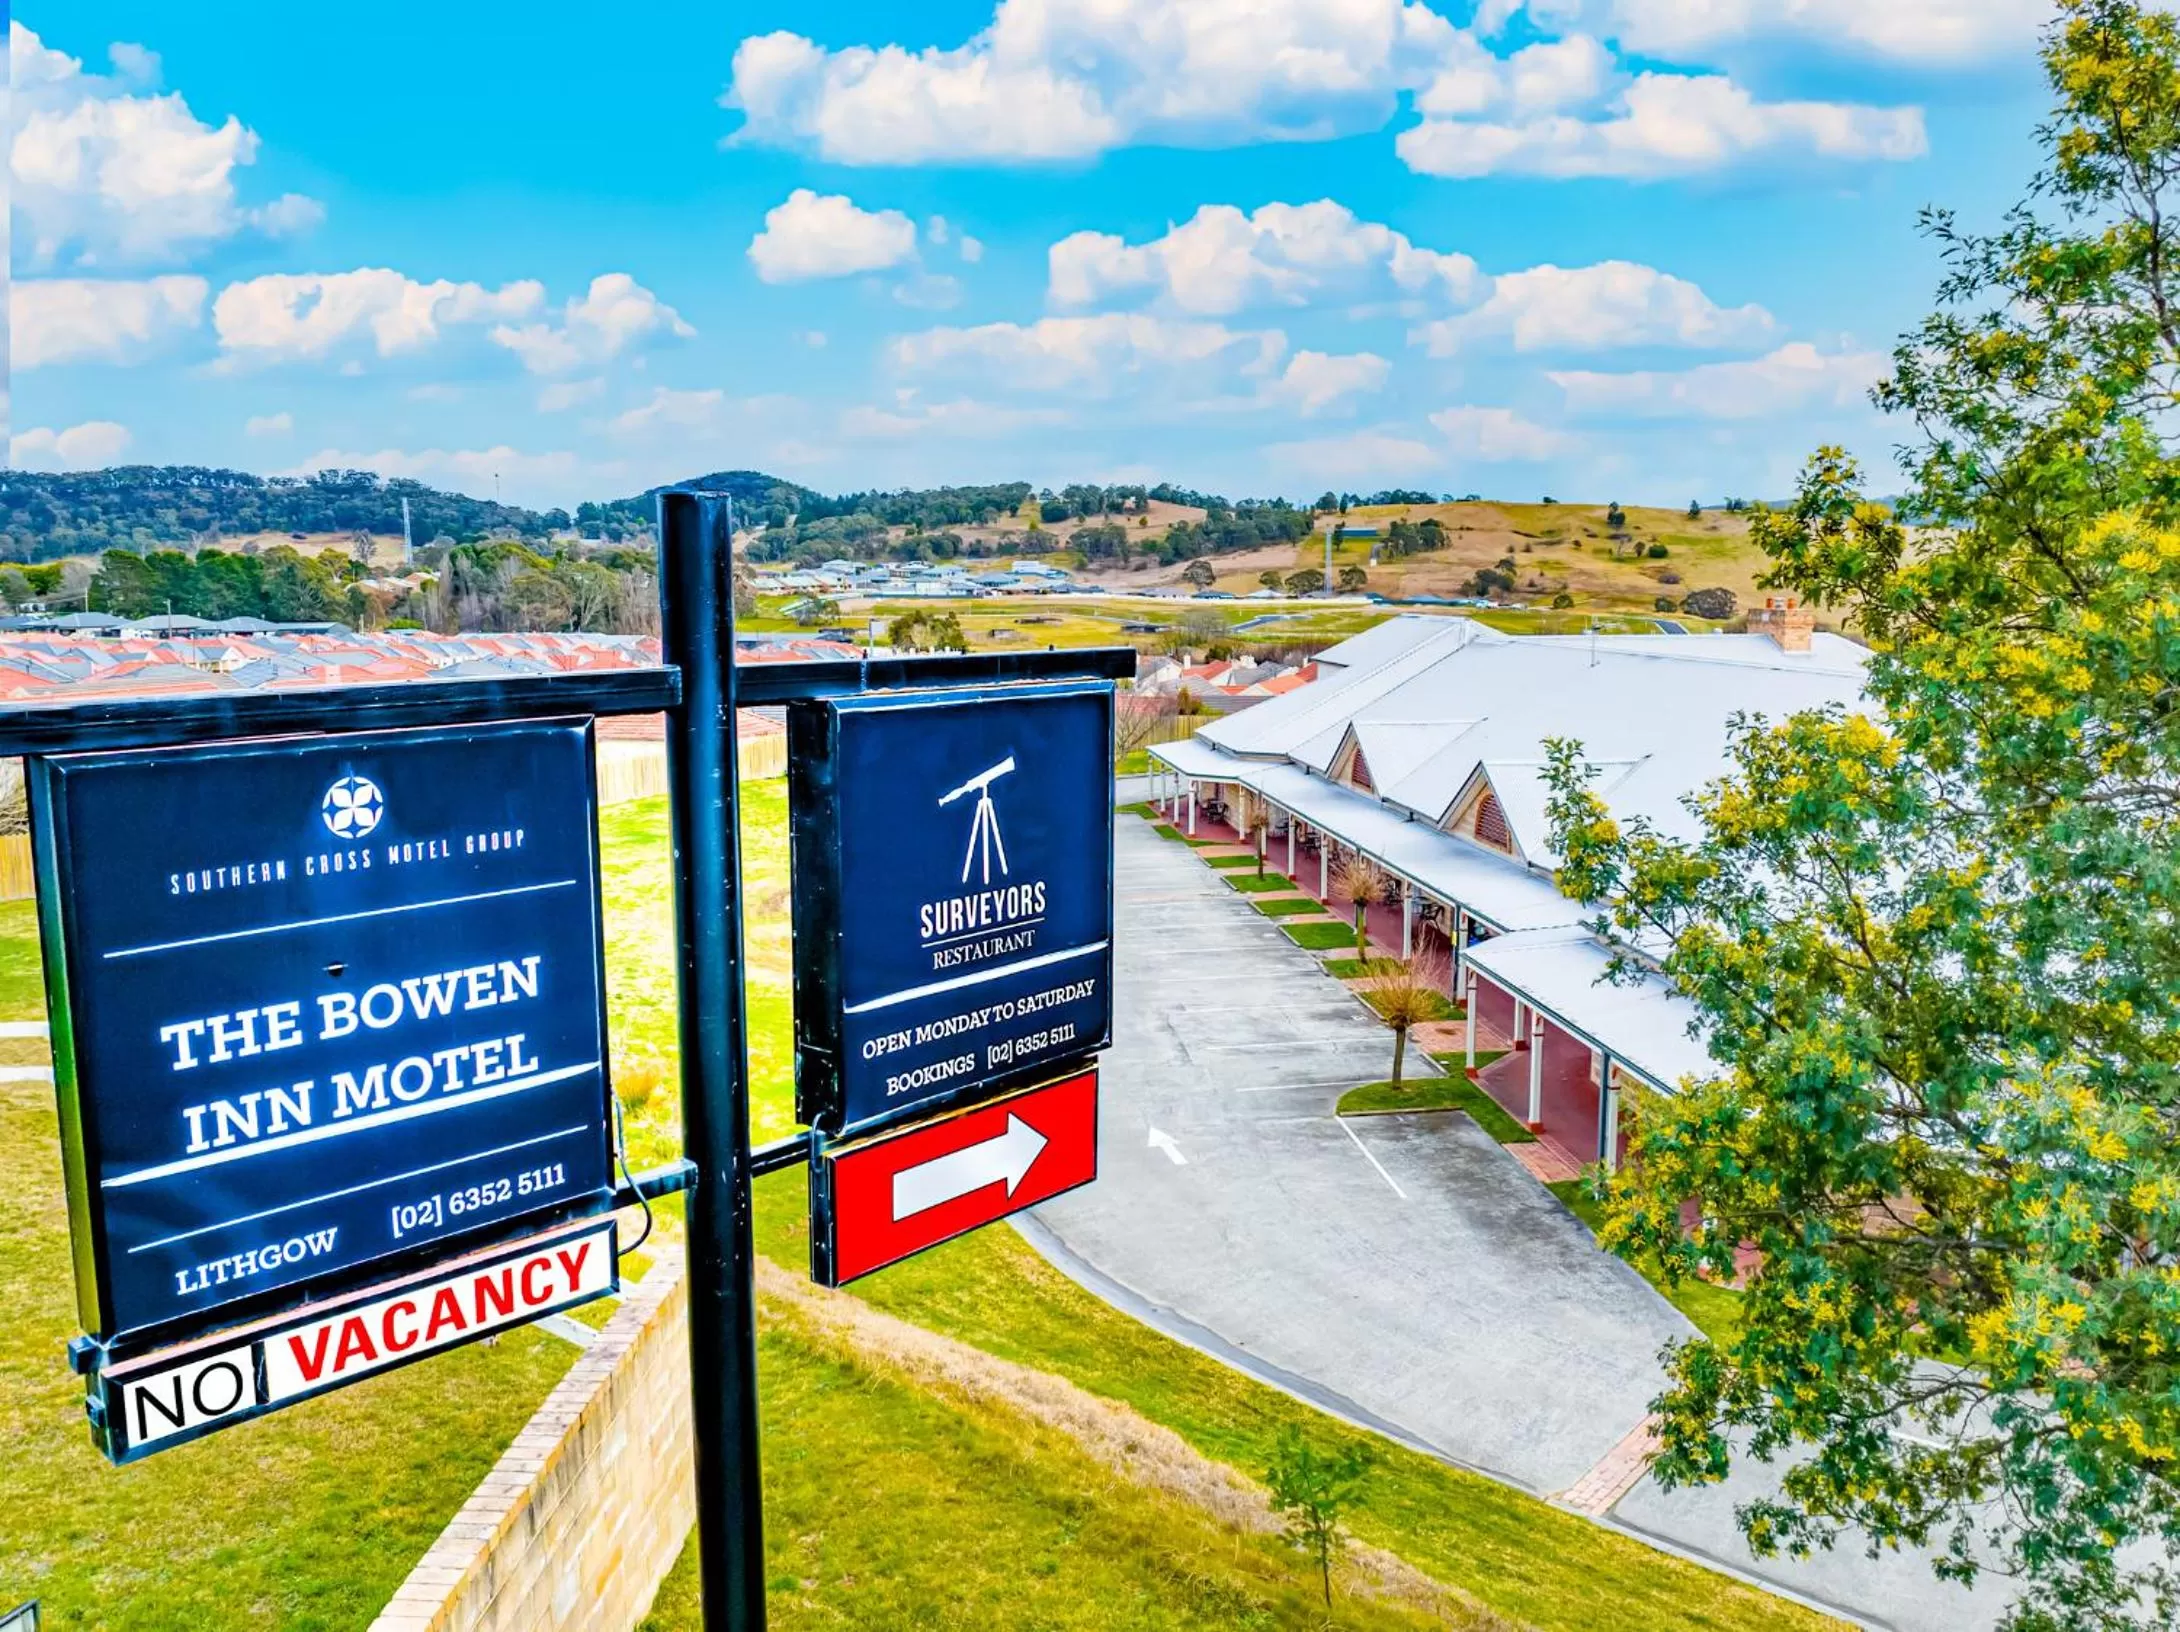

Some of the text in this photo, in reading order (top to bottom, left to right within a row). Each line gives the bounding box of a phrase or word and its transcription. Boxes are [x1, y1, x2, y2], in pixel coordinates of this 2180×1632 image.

[170, 829, 525, 896] SOUTHERN CROSS MOTEL GROUP
[920, 881, 1046, 939] SURVEYORS
[932, 930, 1036, 970] RESTAURANT
[160, 955, 542, 1072] THE BOWEN
[862, 979, 1096, 1060] OPEN MONDAY TO SATURDAY
[182, 1034, 539, 1154] INN MOTEL
[886, 1023, 1076, 1097] BOOKINGS [02] 6352 5111
[175, 1163, 566, 1296] LITHGOW [02] 6352 5111
[134, 1242, 591, 1441] NO VACANCY
